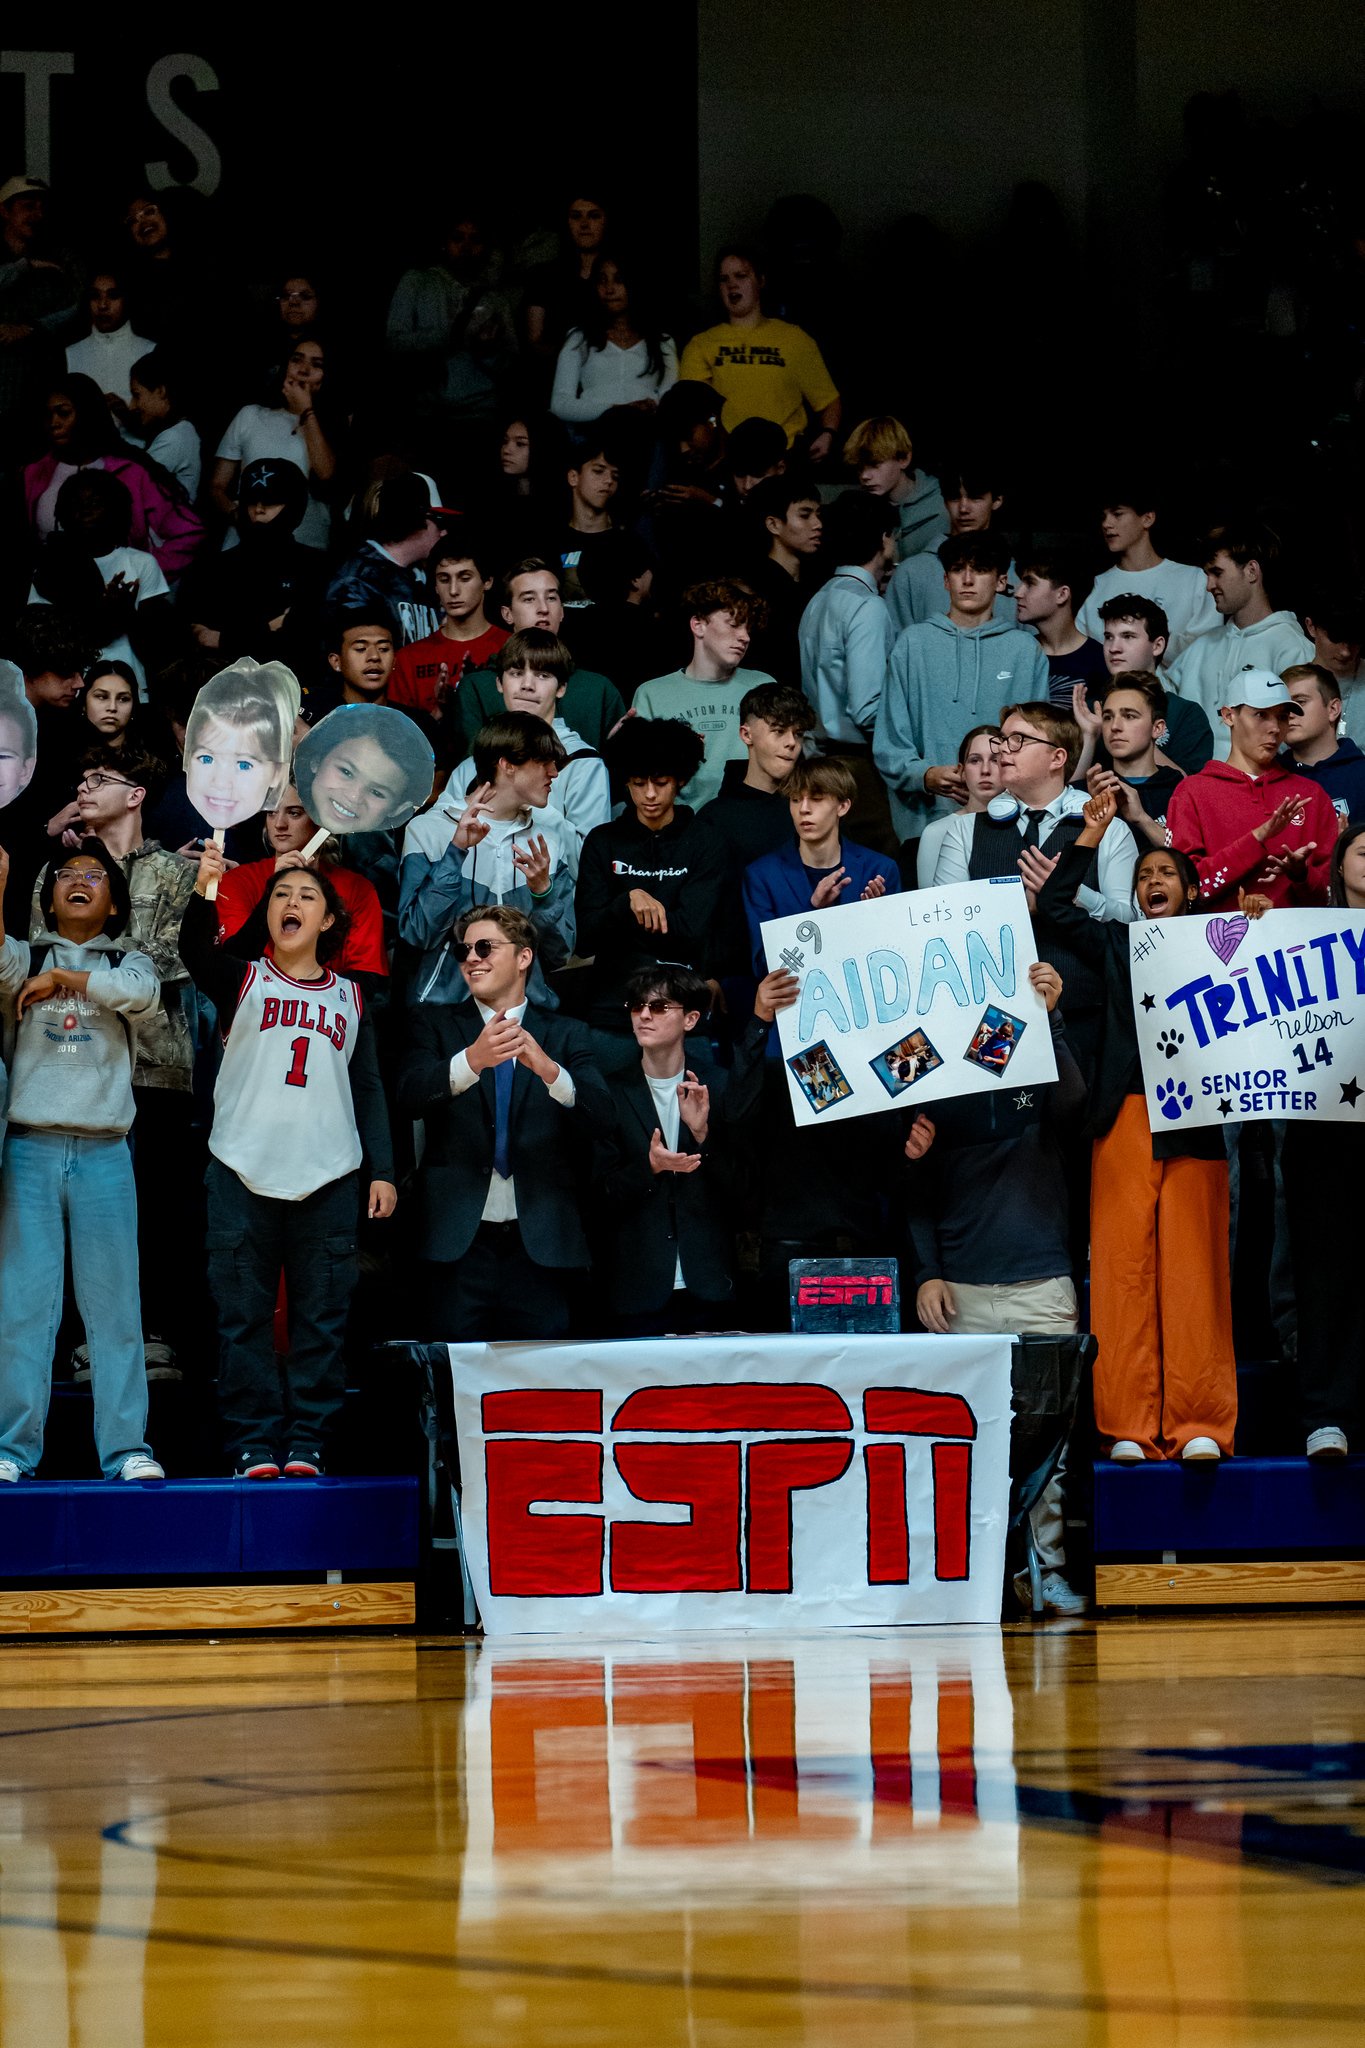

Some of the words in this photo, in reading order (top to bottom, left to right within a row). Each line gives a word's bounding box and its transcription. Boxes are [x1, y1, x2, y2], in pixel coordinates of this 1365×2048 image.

[612, 860, 688, 881] Champion
[908, 900, 952, 927] Let's
[964, 904, 981, 921] go
[779, 920, 823, 975] #9
[1133, 925, 1165, 963] #14
[798, 924, 1016, 1042] AIDAN
[260, 997, 347, 1051] BULLS
[57, 1044, 77, 1053] 2018
[285, 1036, 310, 1088] 1
[1293, 1037, 1333, 1074] 14
[1201, 1069, 1287, 1096] SENIOR
[1240, 1091, 1317, 1112] SETTER
[798, 1275, 893, 1306] ESPN
[480, 1382, 978, 1598] ESPN
